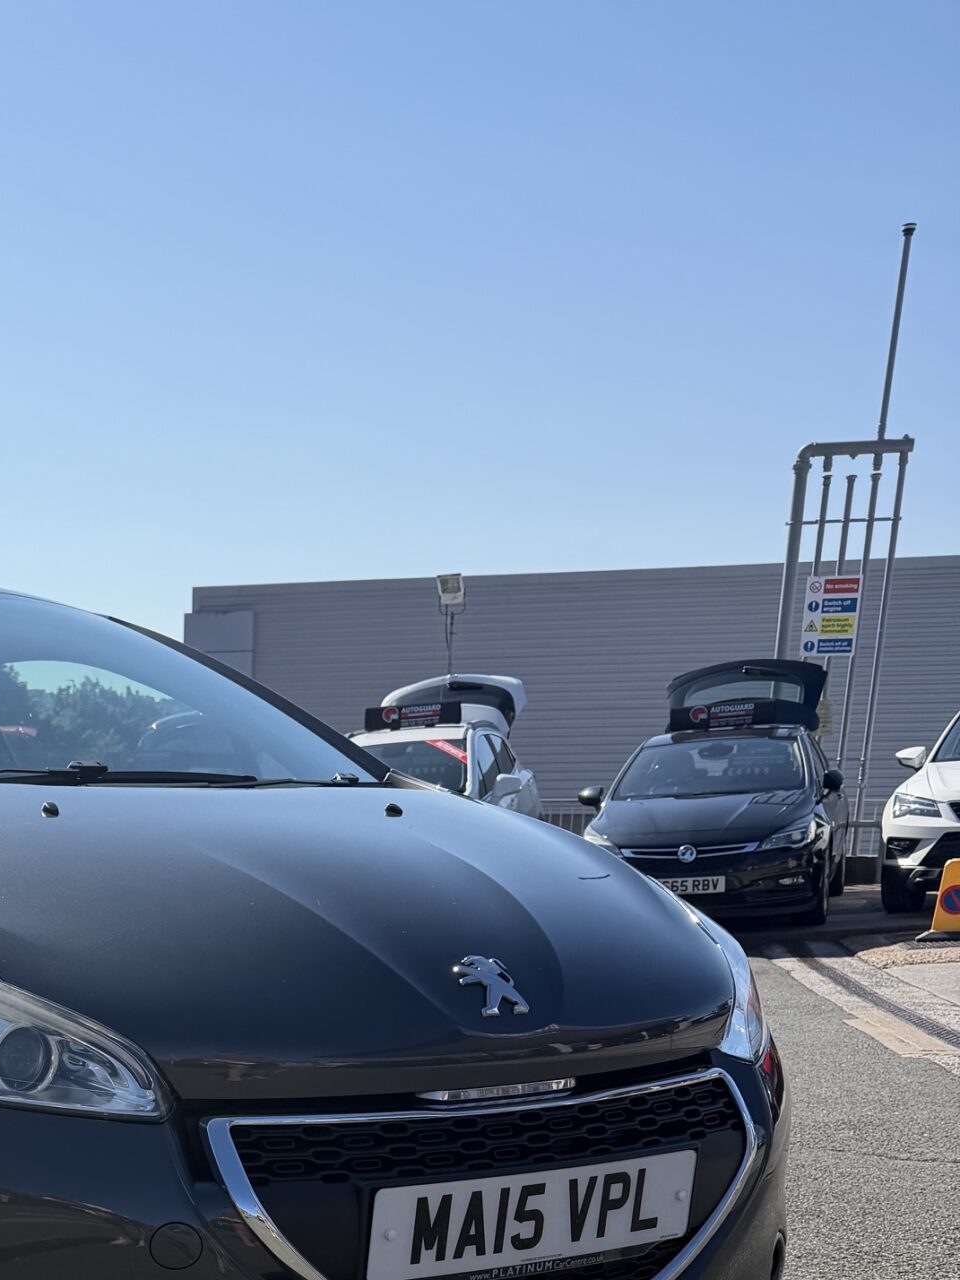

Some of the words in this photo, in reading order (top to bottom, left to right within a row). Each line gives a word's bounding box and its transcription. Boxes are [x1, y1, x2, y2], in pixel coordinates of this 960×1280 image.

[401, 704, 441, 713] AUTOGUARD
[710, 703, 755, 713] AUTOGUARD
[661, 880, 688, 892] S65
[692, 878, 720, 891] RBV
[409, 1183, 546, 1265] MA15
[569, 1168, 658, 1243] VPL
